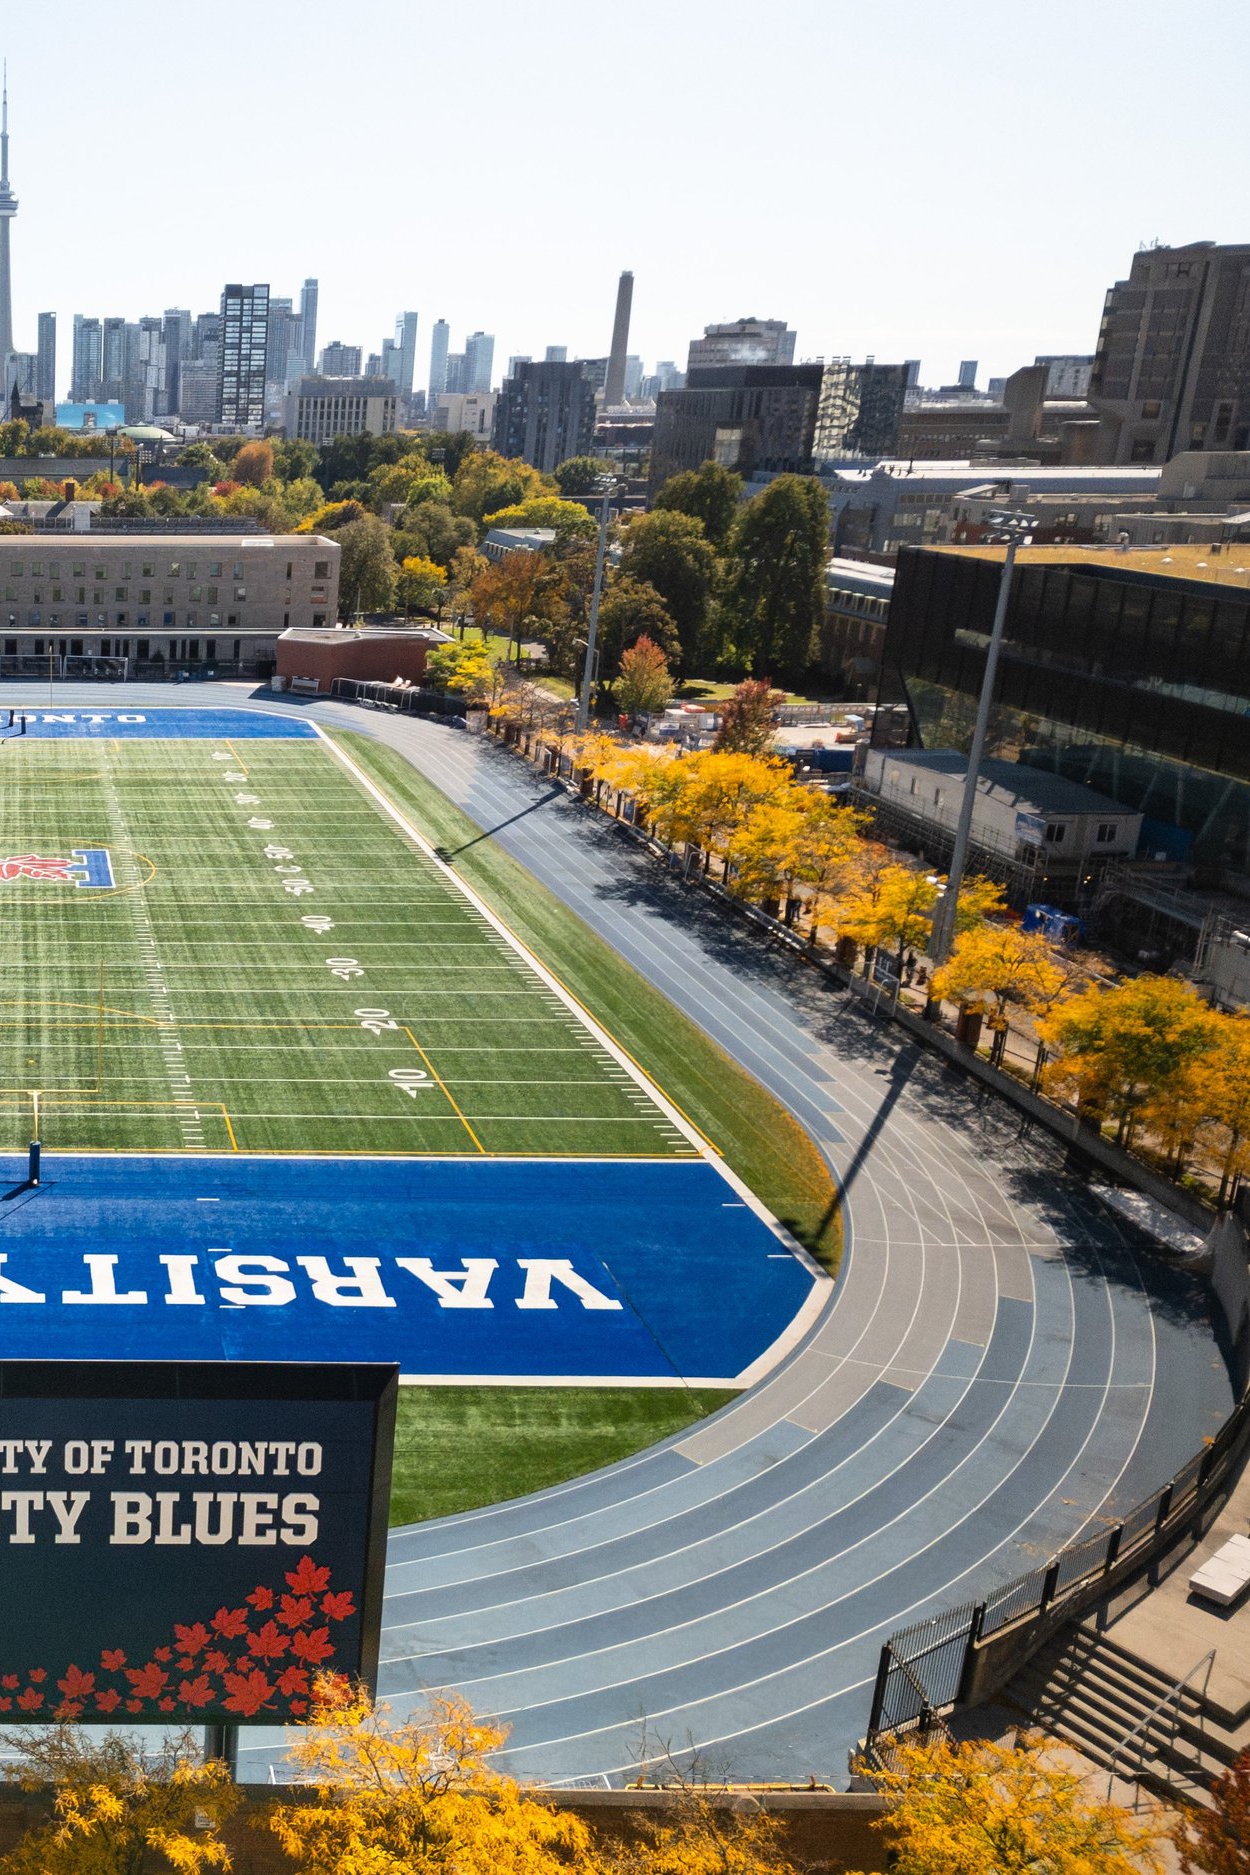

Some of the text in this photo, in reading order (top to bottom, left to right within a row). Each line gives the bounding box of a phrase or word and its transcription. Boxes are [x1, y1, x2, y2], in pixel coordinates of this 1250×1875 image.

[263, 846, 294, 859] 50
[273, 865, 302, 873] C
[281, 879, 314, 893] 50
[301, 915, 335, 931] 40
[325, 957, 365, 977] 30
[354, 1007, 399, 1030] 20
[388, 1068, 435, 1093] 10
[64, 1440, 115, 1475] OF
[125, 1440, 323, 1477] TORONTO
[109, 1491, 320, 1546] BLUES
